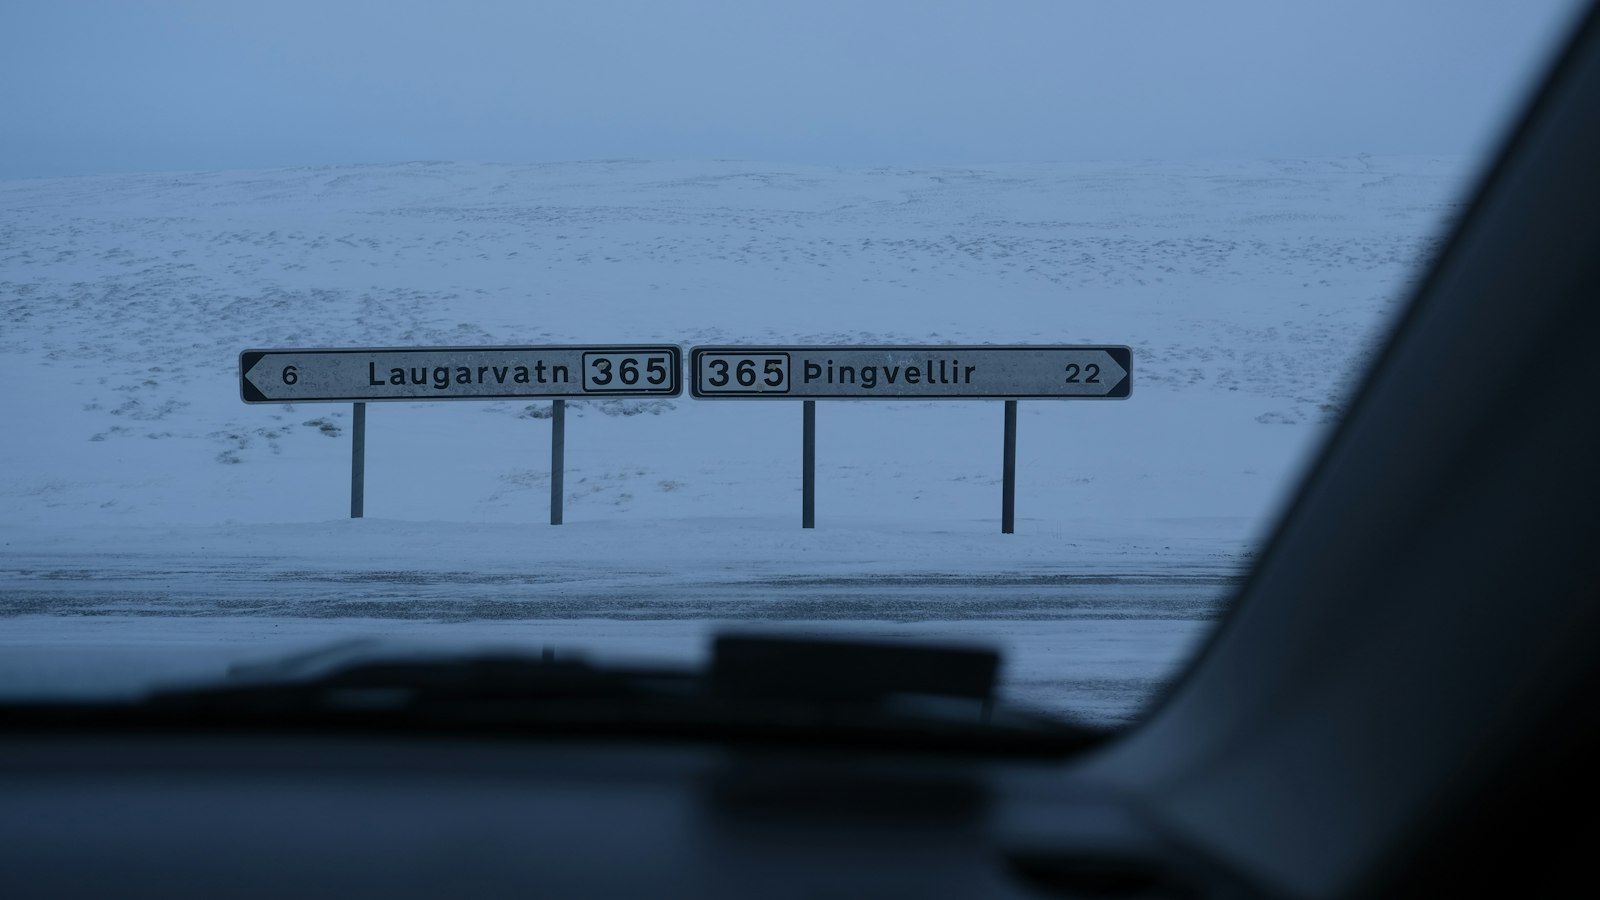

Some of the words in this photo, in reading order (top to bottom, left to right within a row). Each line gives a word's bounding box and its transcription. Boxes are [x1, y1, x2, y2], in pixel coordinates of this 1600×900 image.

[282, 365, 298, 385] 6
[369, 360, 569, 390] Laugarvatn
[591, 357, 667, 386] 365
[708, 359, 785, 387] 365
[804, 359, 976, 389] Þingvellir
[1065, 363, 1101, 384] 22
